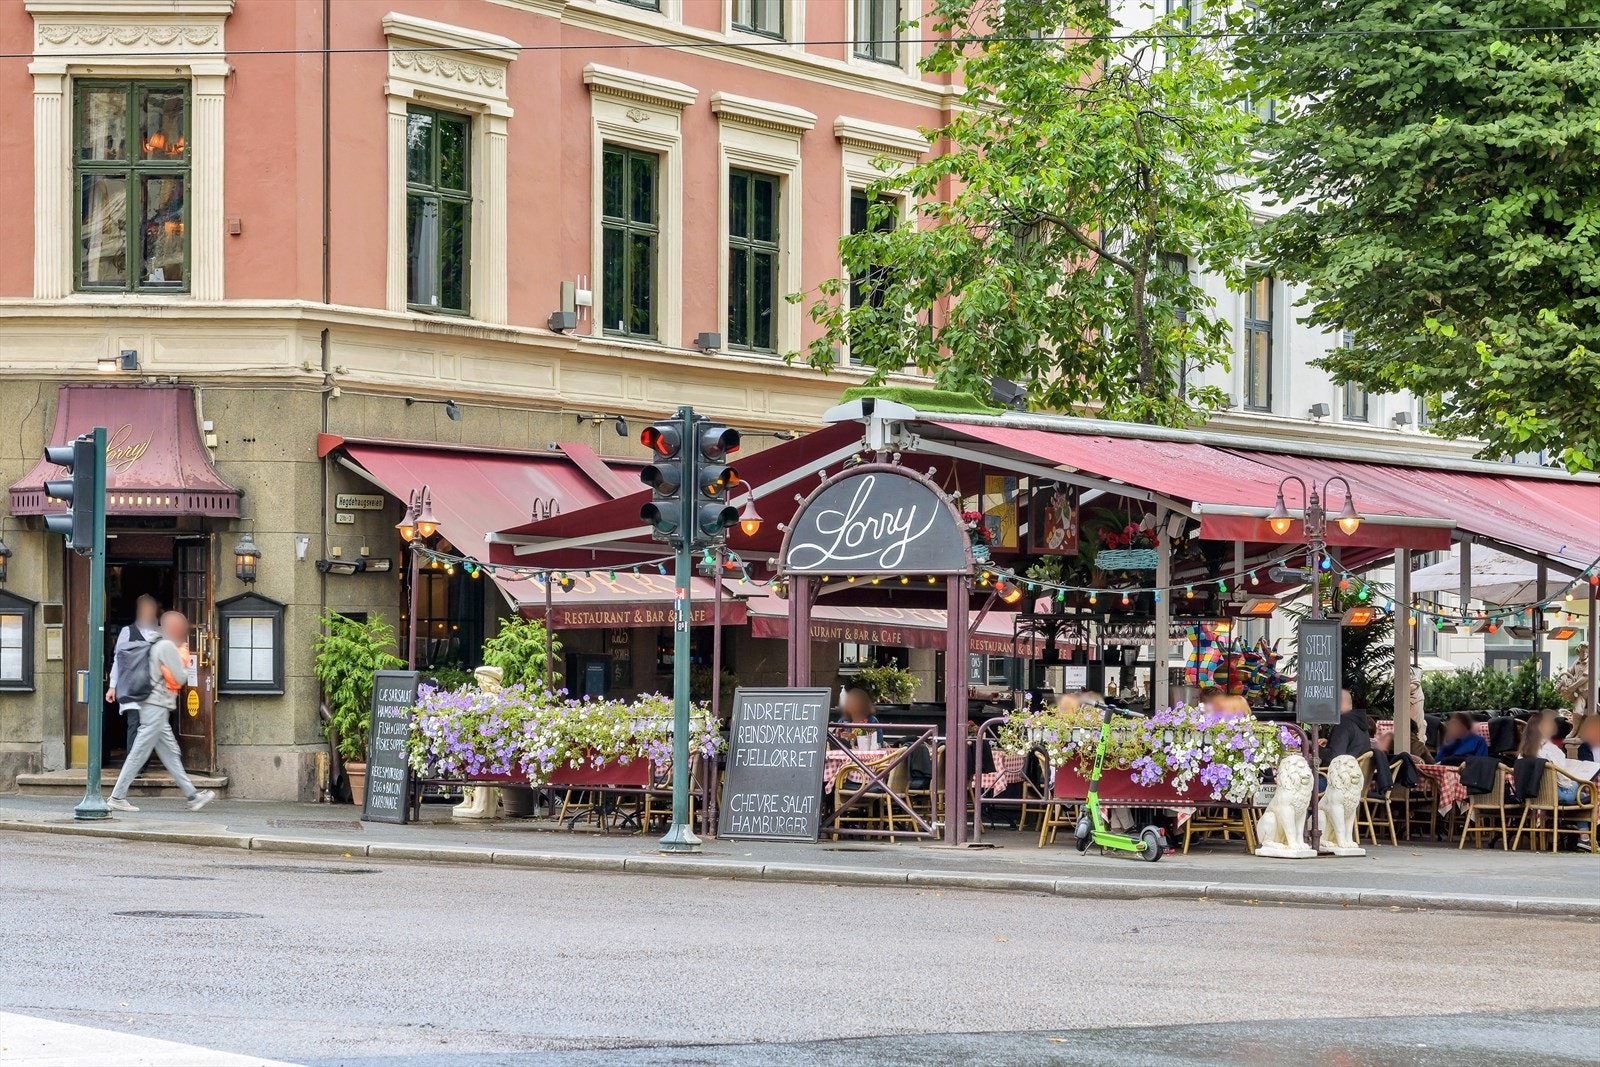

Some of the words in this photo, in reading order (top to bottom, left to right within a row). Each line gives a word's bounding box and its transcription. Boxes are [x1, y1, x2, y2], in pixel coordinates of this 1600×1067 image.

[339, 496, 383, 508] Hegdehaugsveien
[787, 475, 939, 569] Lorry
[564, 611, 631, 625] RESTAURANT
[634, 610, 643, 623] &
[646, 610, 665, 622] BAR
[844, 628, 852, 640] &
[854, 629, 869, 641] BAR
[872, 631, 879, 643] &
[881, 630, 902, 643] CAFE
[1305, 634, 1332, 656] STEKT
[1018, 644, 1025, 655] &
[743, 702, 821, 720] INDREFILET
[737, 725, 819, 744] REINSDYRKAKER
[735, 748, 817, 767] FJELLØRRET
[730, 793, 779, 813] CHEVRE
[780, 795, 815, 814] SALAT
[731, 815, 808, 835] HAMBURGER
